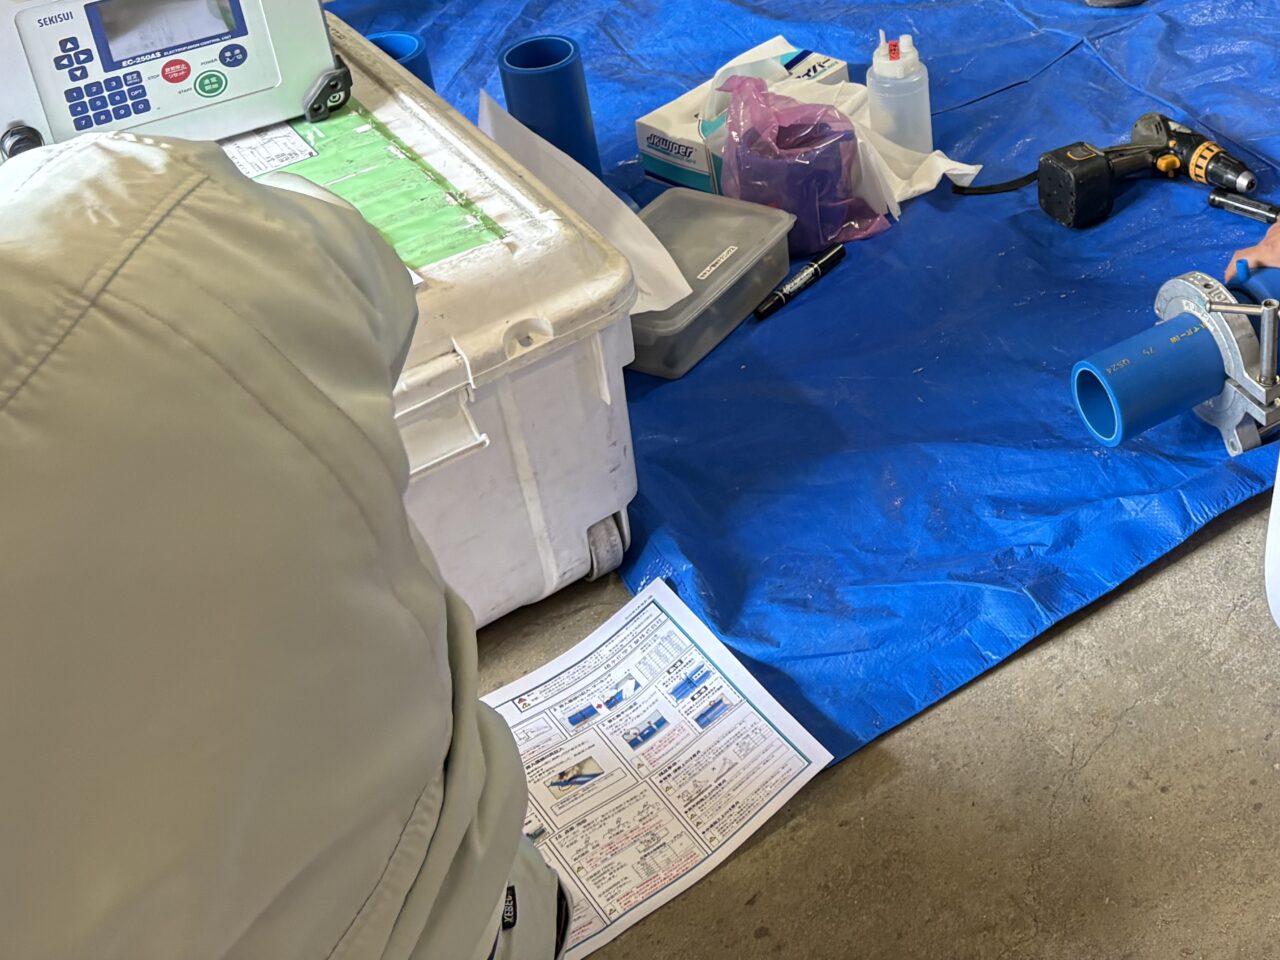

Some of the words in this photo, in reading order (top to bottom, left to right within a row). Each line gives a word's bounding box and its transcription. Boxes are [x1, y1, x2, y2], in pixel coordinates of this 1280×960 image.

[37, 11, 74, 28] SEKISUI
[121, 51, 162, 67] EC-250AS
[795, 58, 831, 80] イパー
[503, 895, 514, 923] XEBEC
